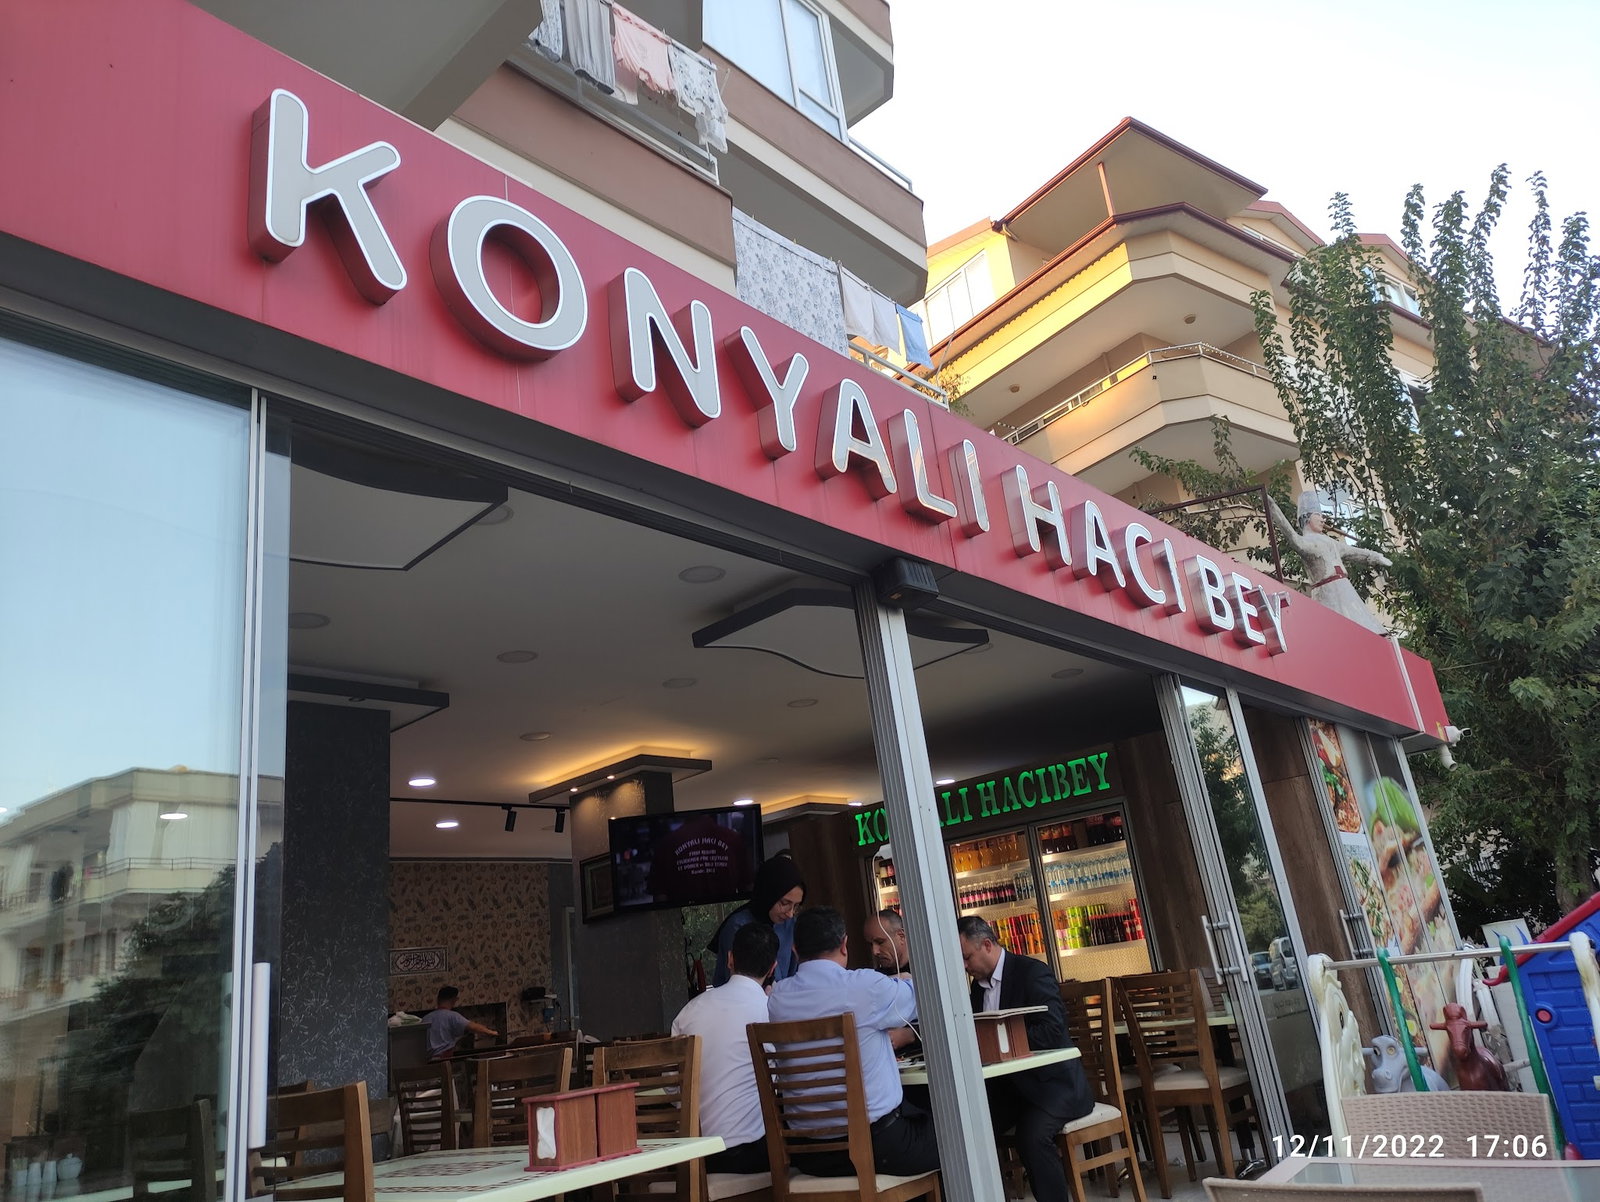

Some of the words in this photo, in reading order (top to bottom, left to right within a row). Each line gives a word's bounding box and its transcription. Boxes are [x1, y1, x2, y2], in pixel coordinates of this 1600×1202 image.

[263, 87, 990, 533] KONYALI
[1012, 463, 1187, 614] HACI
[1194, 553, 1289, 655] BEY
[854, 787, 973, 847] KOLI
[976, 751, 1112, 818] HACIBEY
